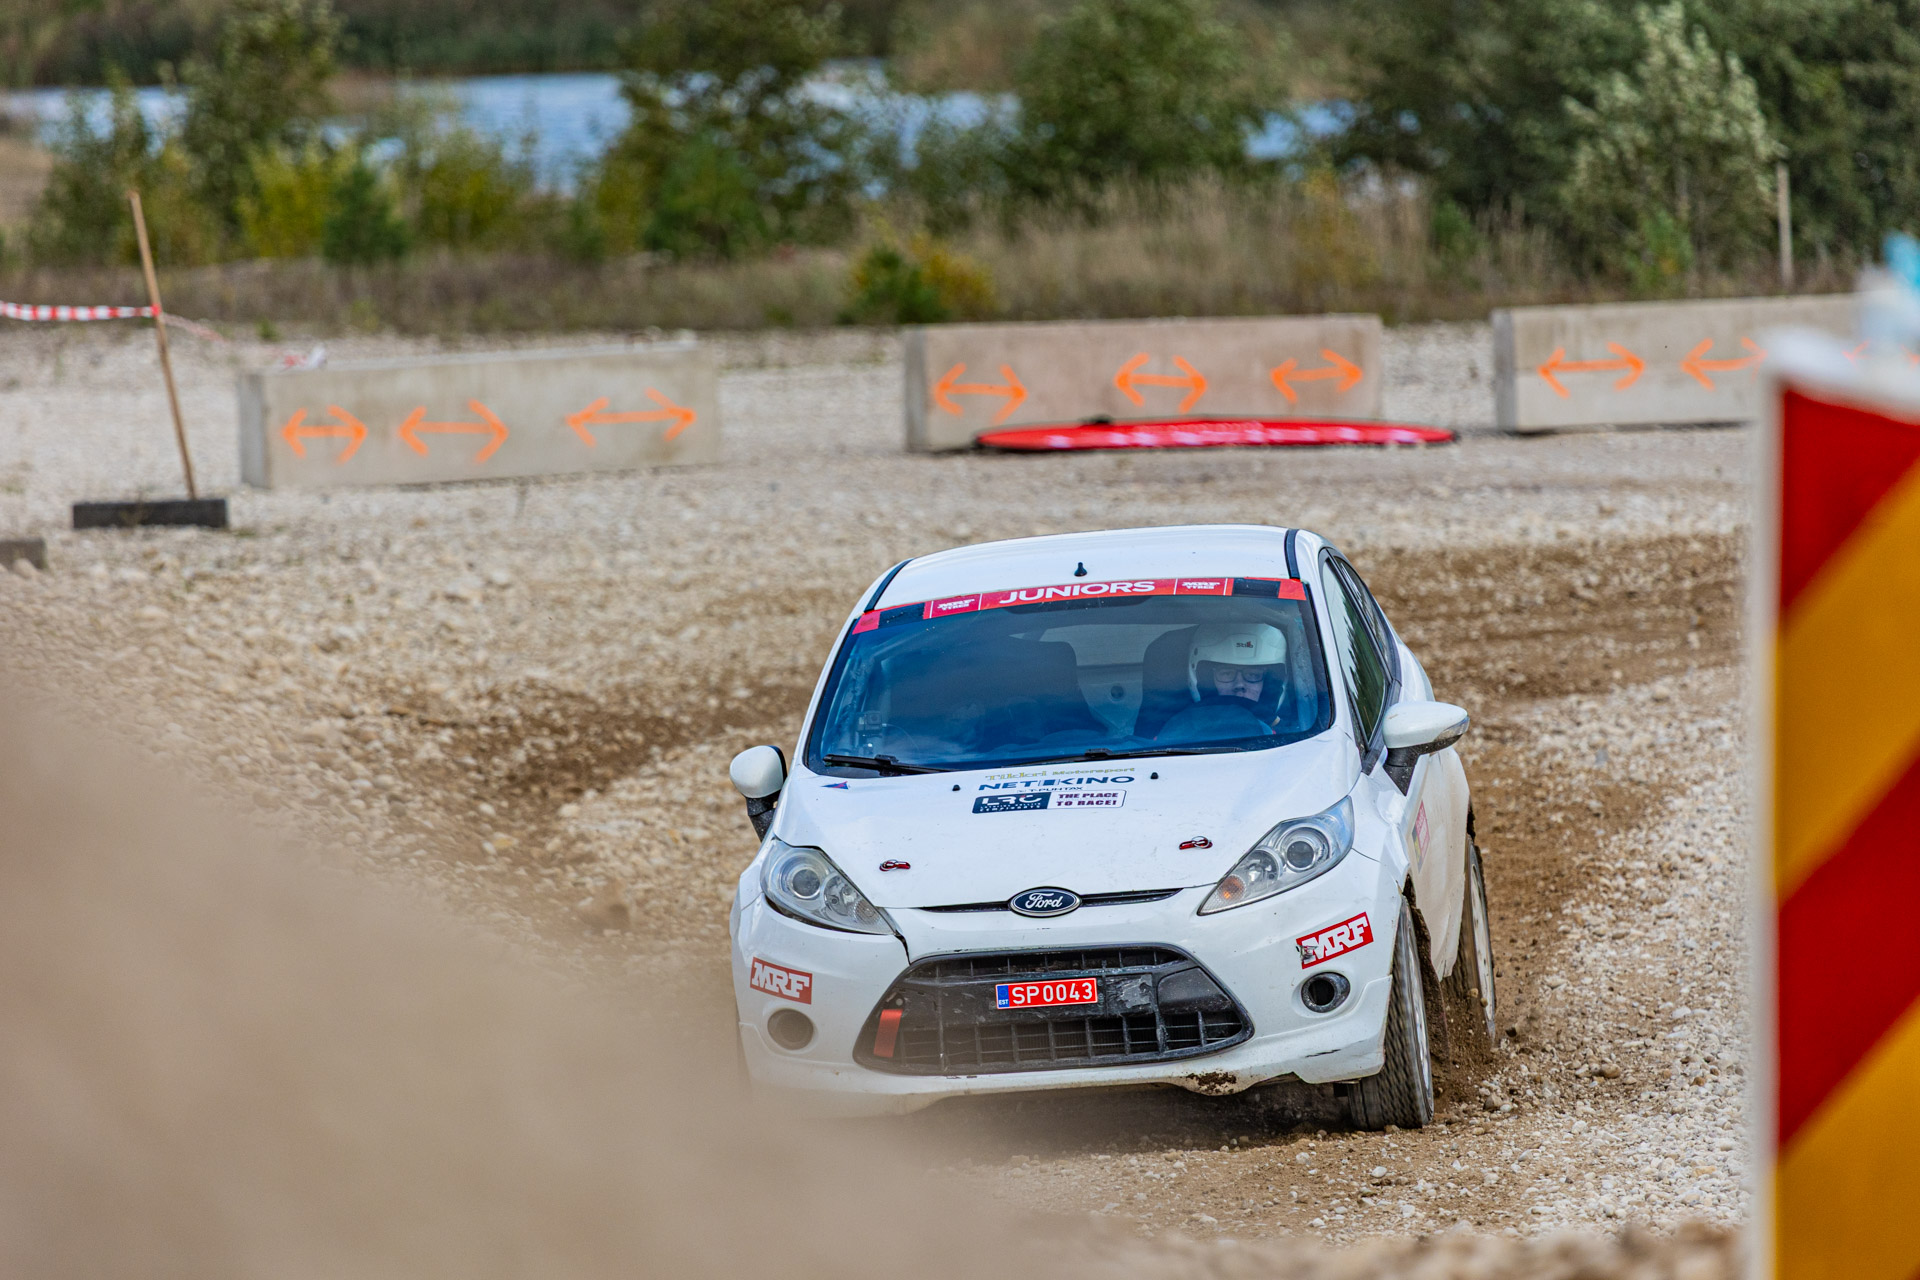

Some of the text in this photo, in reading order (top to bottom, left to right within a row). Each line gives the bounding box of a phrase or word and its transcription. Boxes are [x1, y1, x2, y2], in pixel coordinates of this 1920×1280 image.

[999, 581, 1155, 604] JUNIORS
[1025, 892, 1063, 909] Ford
[1301, 915, 1369, 965] MRF
[751, 961, 810, 999] MRF
[1011, 982, 1093, 1005] SP0043
